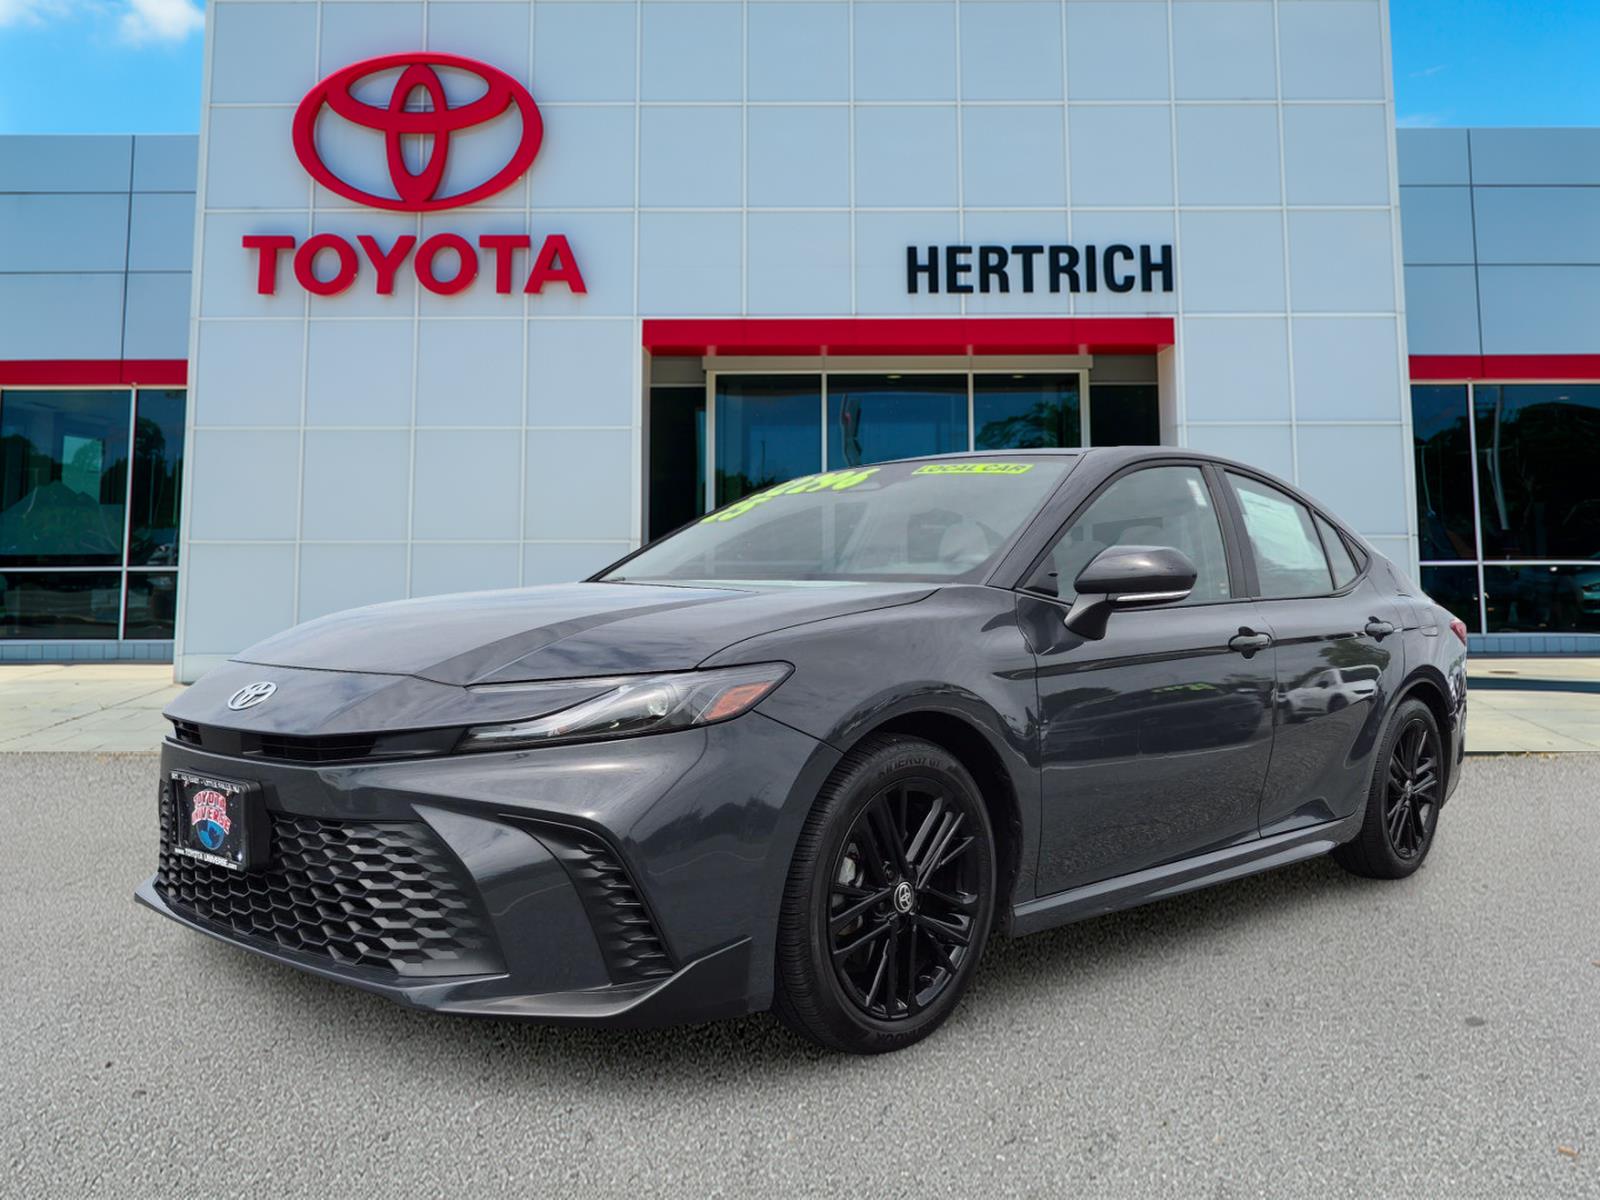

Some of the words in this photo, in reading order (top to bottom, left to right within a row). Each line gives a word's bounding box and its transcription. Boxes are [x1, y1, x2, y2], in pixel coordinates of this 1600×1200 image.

[242, 233, 587, 296] TOYOTA
[906, 244, 1173, 294] HERTRICH
[982, 463, 1027, 473] CAR
